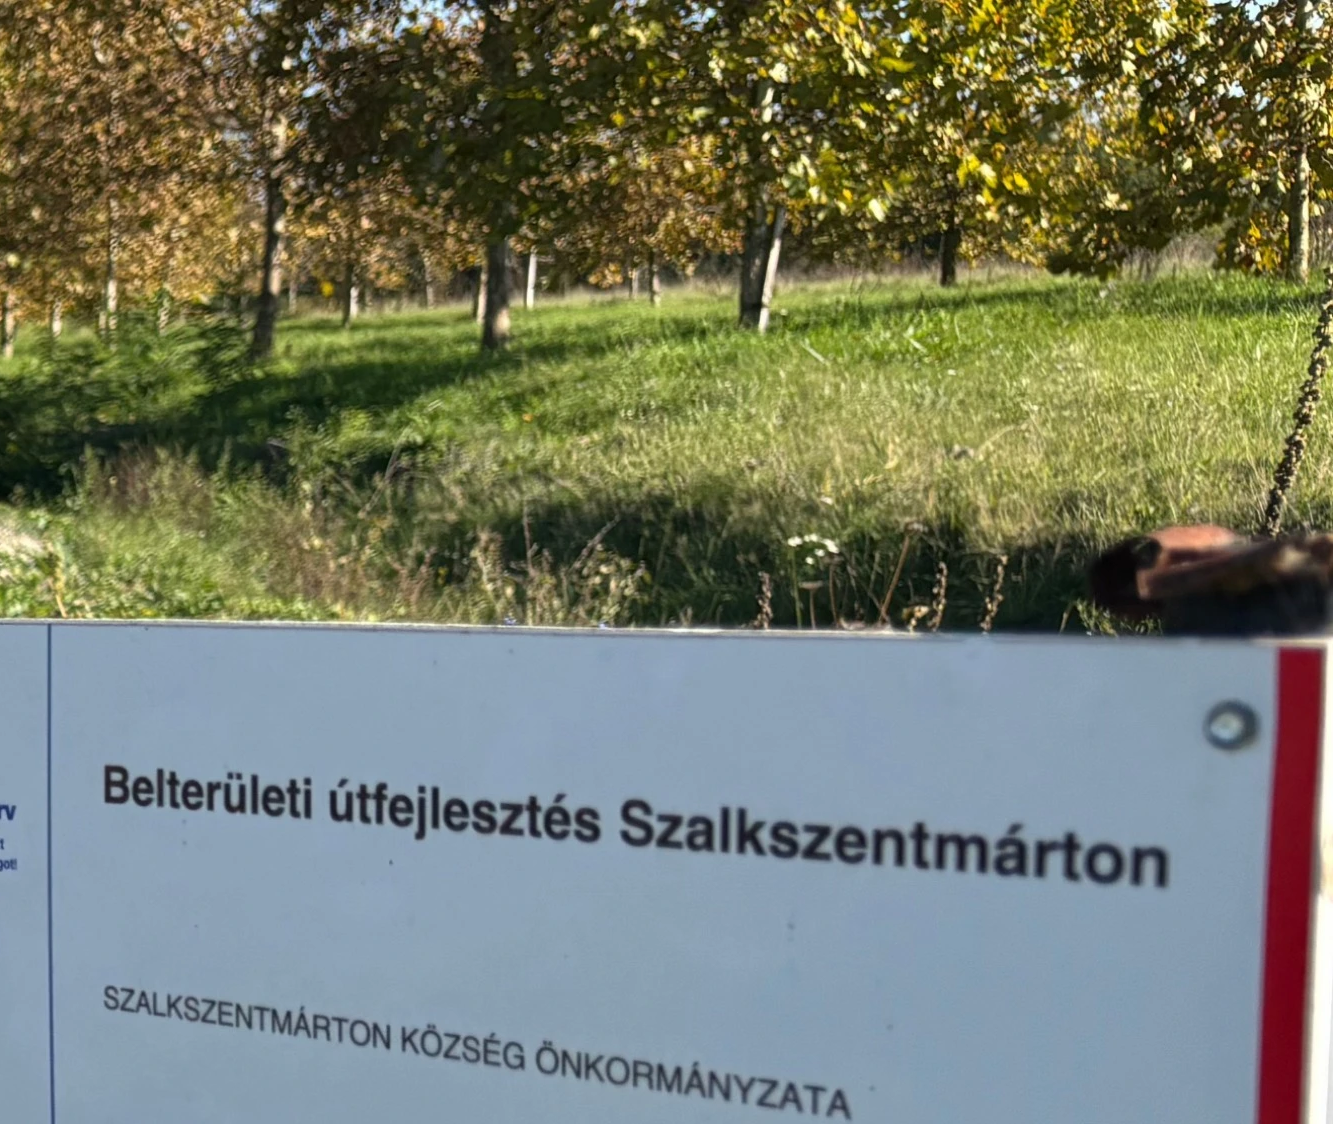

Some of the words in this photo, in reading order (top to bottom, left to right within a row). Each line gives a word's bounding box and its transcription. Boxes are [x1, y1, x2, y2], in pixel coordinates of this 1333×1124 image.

[104, 765, 312, 820] Belterületi
[329, 778, 601, 844] útfejlesztés
[619, 798, 1170, 889] Szalkszentmárton
[104, 985, 391, 1050] SZALKSZENTMÁRTON
[401, 1024, 525, 1070] KÖZSÉG
[535, 1040, 852, 1120] ÖNKORMÁNYZATA
